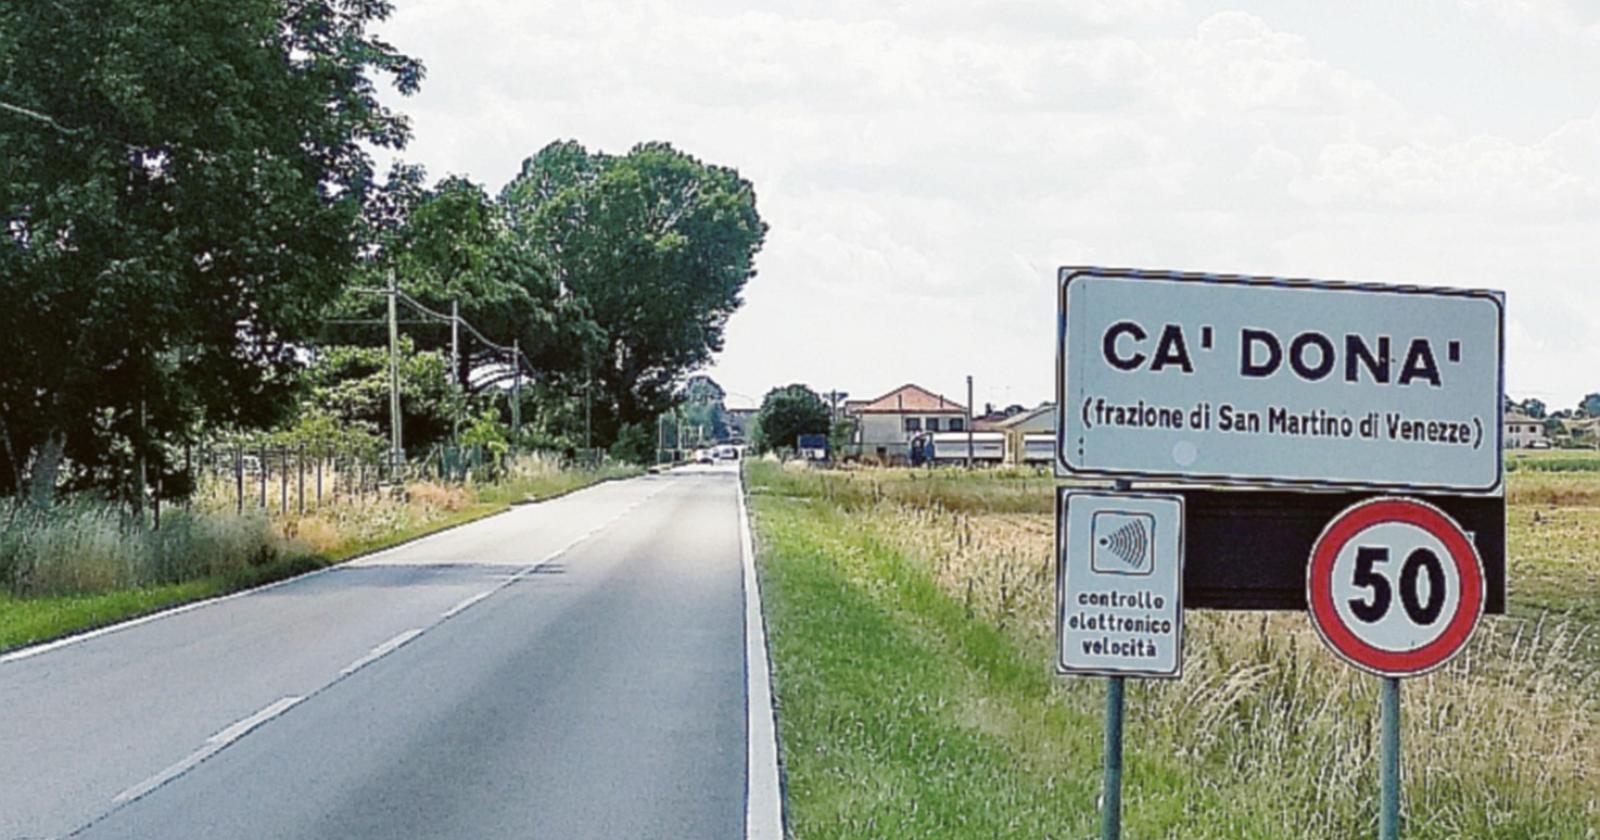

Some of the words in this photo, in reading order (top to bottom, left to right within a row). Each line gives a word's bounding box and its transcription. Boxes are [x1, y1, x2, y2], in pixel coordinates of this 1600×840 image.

[1102, 321, 1212, 373] CA'
[1240, 328, 1461, 387] DONA'
[1081, 396, 1183, 430] (frazione
[1190, 403, 1210, 430] di
[1218, 404, 1260, 433] San
[1268, 406, 1353, 438] Martino
[1359, 410, 1379, 439] di
[1386, 413, 1483, 449] Venezze)
[1078, 591, 1165, 609] controllo
[1347, 545, 1446, 625] 50
[1069, 613, 1171, 634] elettronico
[1082, 636, 1157, 657] velocità
